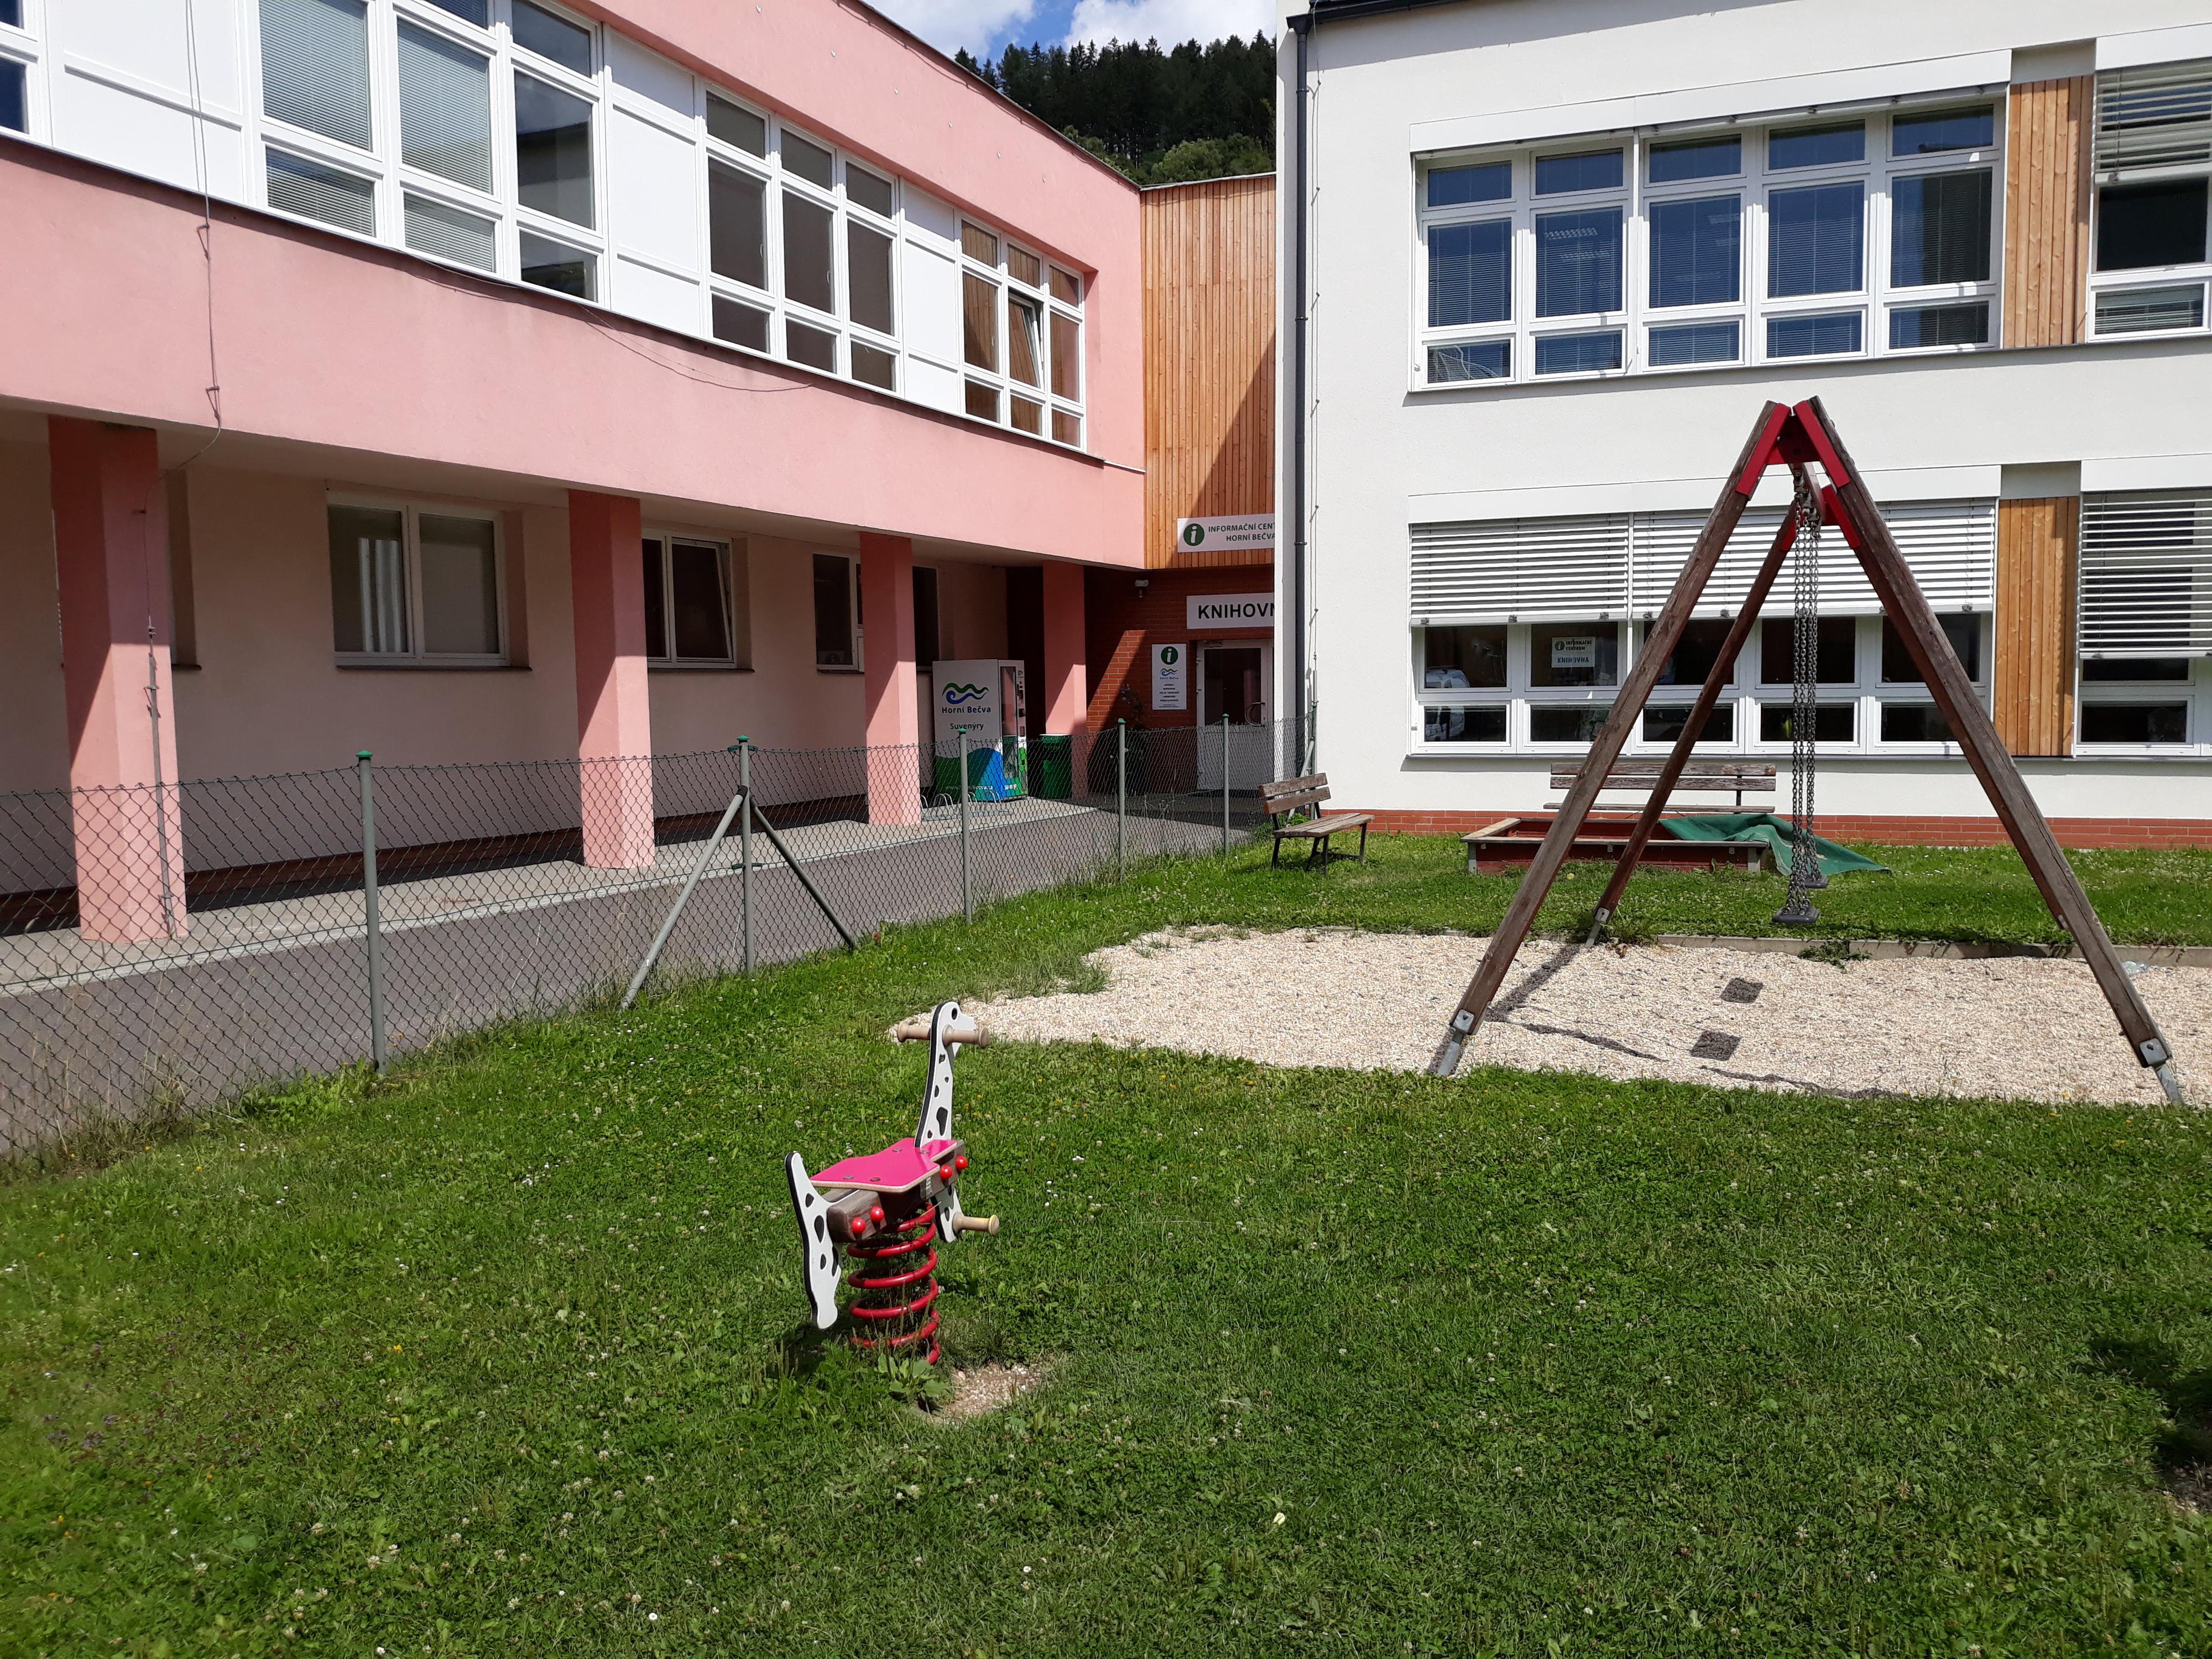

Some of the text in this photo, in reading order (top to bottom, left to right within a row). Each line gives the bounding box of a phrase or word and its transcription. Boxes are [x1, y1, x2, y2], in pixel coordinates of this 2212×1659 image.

[1208, 523, 1256, 533] INFORMAČNÍ
[1226, 533, 1250, 541] HORNÍ
[950, 722, 984, 731] Suvenýry
